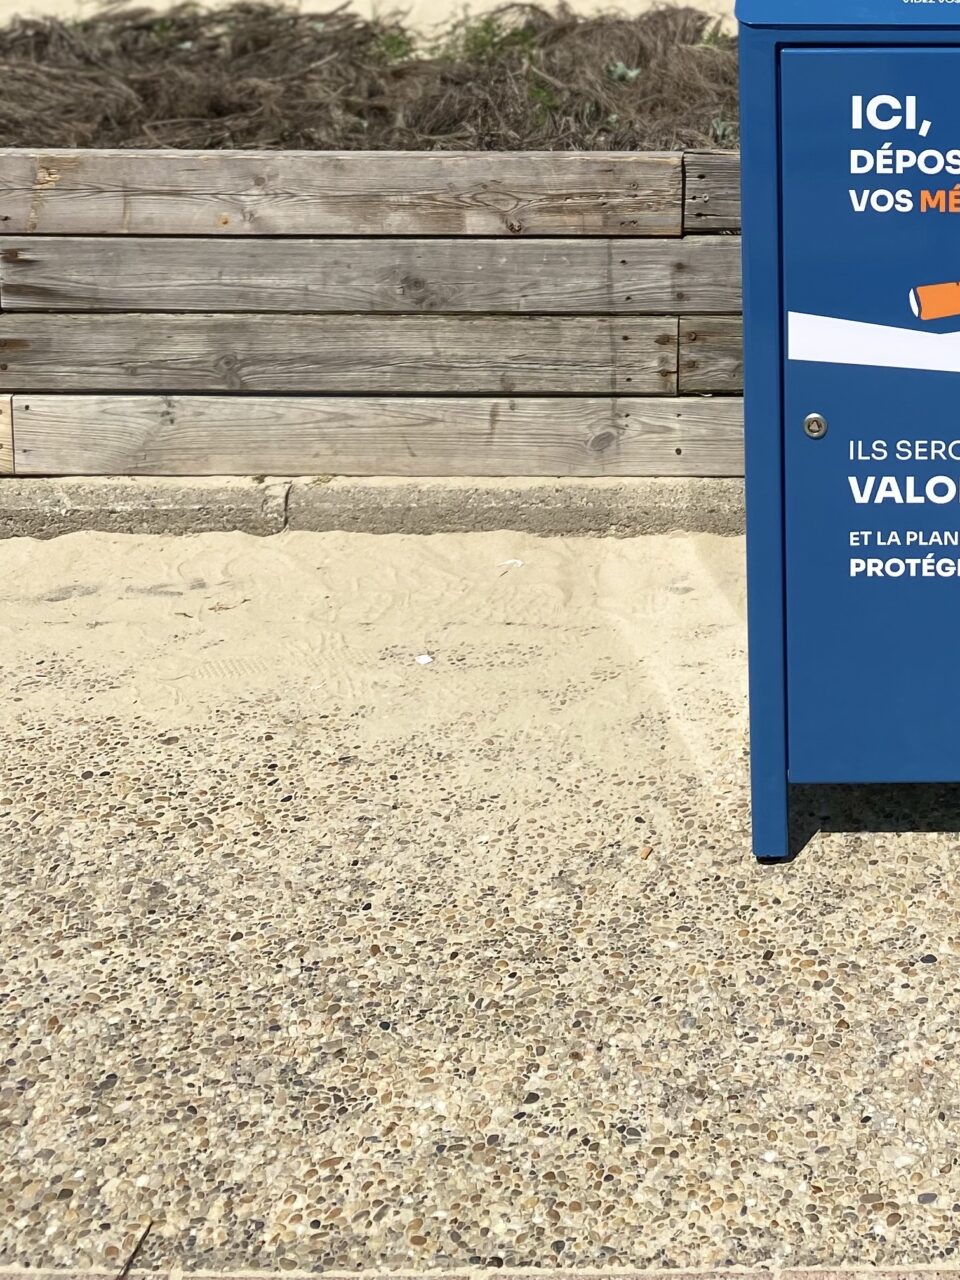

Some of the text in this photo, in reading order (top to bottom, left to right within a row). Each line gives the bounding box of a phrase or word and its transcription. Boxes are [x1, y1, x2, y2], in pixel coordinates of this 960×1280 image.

[851, 94, 932, 137] ICI,
[848, 189, 914, 213] VOS
[849, 439, 888, 461] ILS
[849, 531, 873, 546] ET
[876, 531, 902, 546] LA
